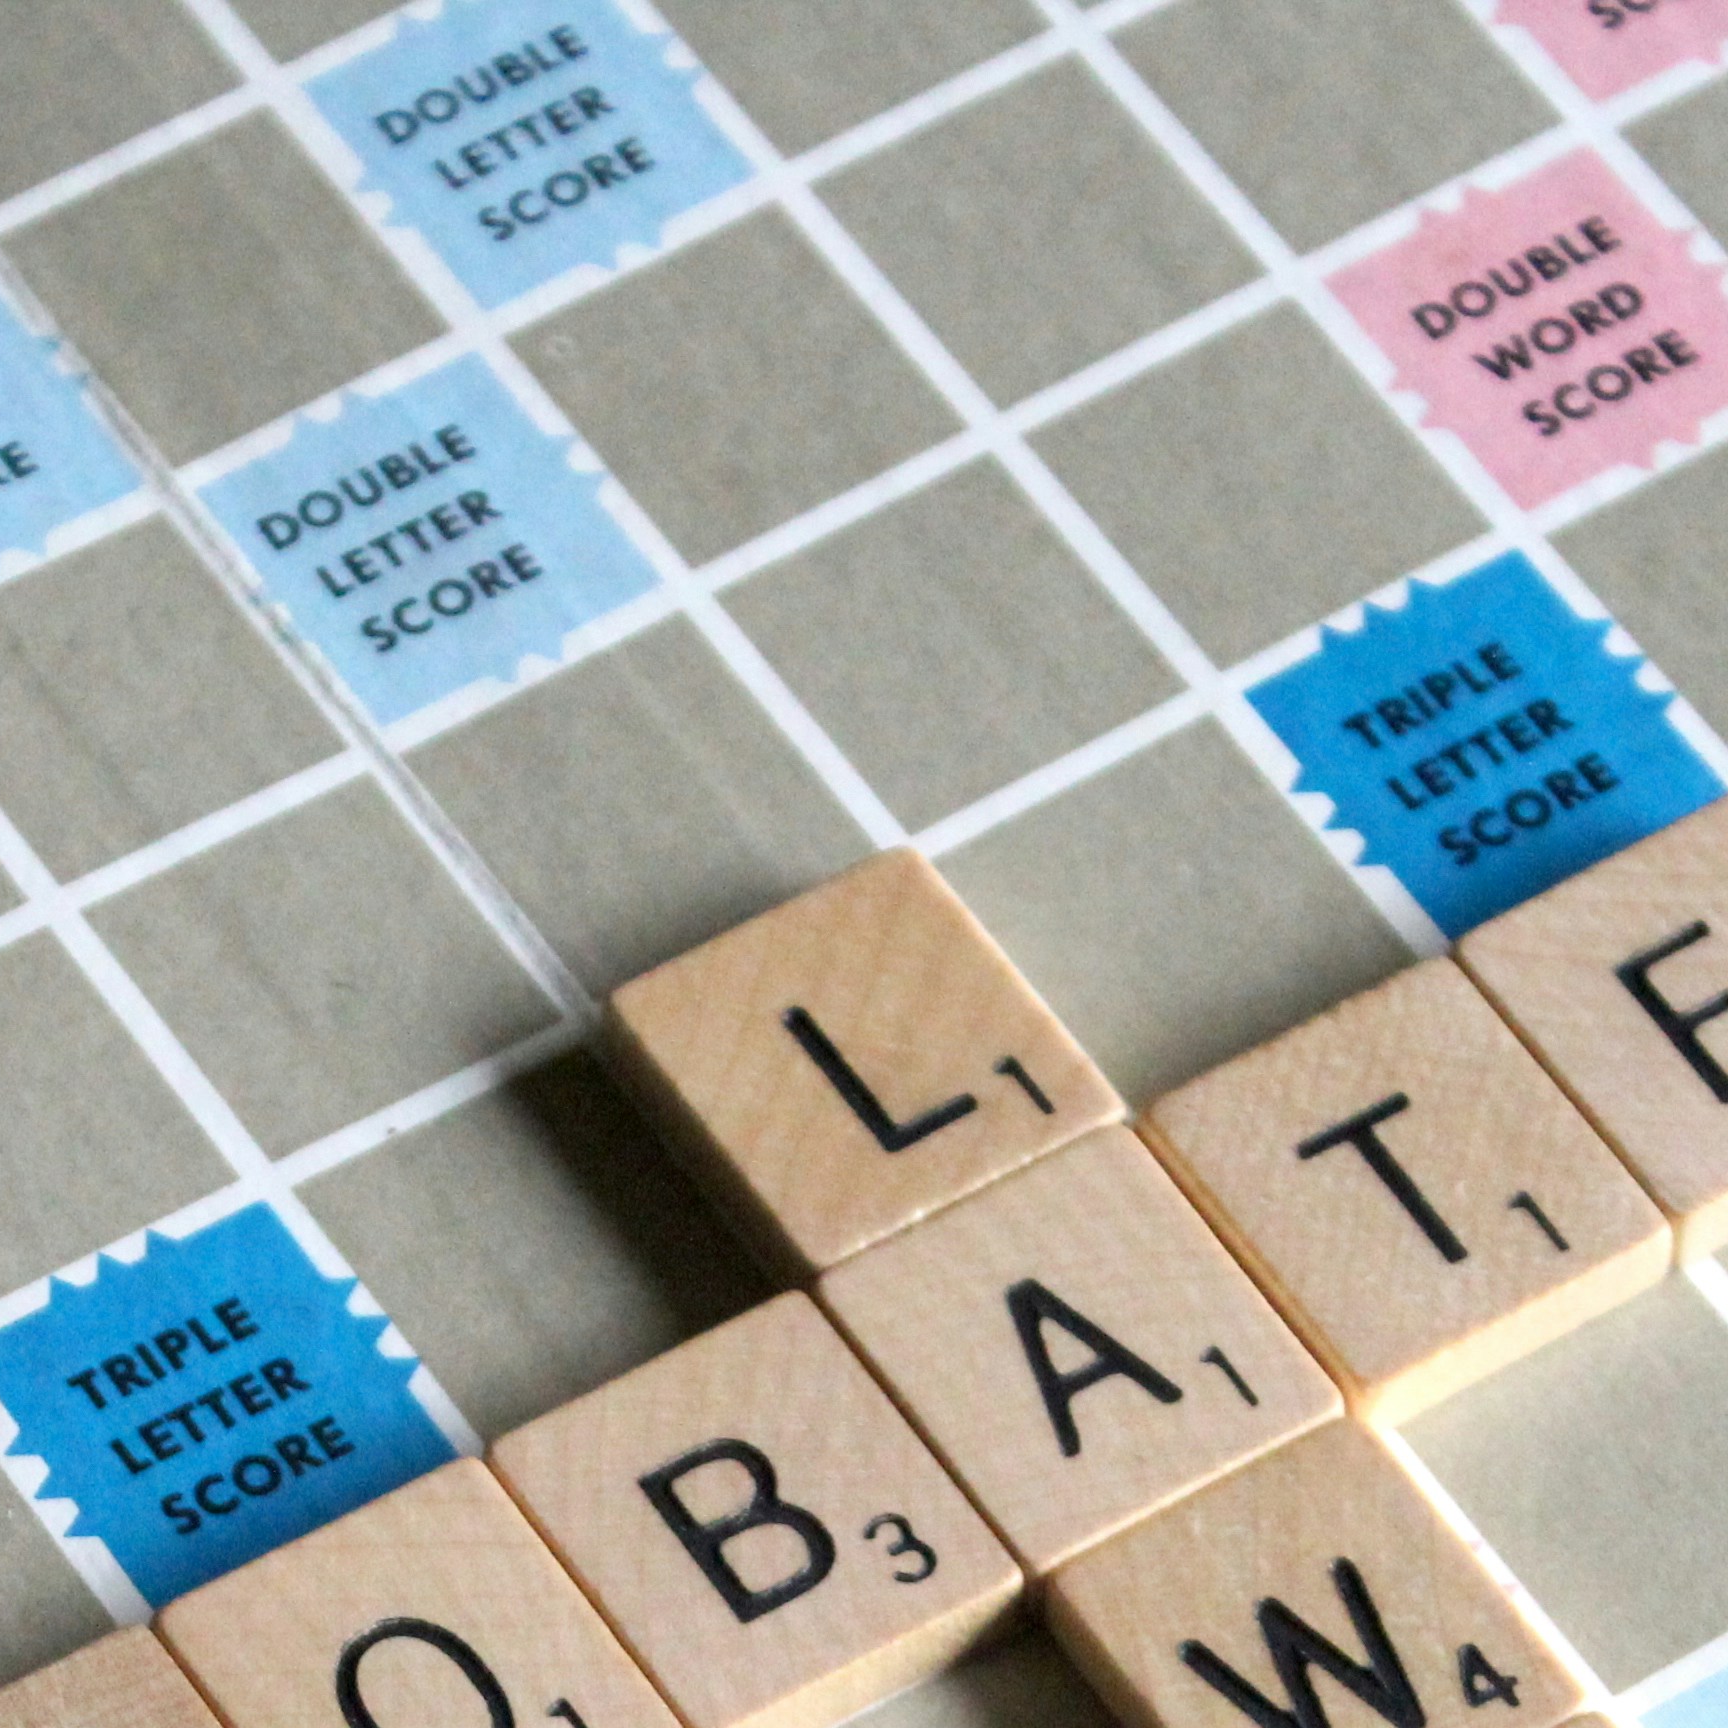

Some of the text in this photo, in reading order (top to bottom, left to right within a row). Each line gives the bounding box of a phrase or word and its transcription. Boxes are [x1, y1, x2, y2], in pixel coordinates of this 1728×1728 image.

[372, 24, 587, 148] DOUBLE
[432, 84, 614, 193] LETTER
[476, 135, 654, 244] SCORE
[1410, 219, 1620, 342] DOUBLE
[1474, 283, 1644, 382] WORD
[1522, 331, 1697, 438] SCORE
[256, 426, 475, 552] DOUBLE
[316, 490, 498, 600] LETTER
[360, 544, 541, 654] SCORE
[1342, 643, 1521, 750] TRIPLE
[1386, 698, 1574, 812] LETTER
[1438, 753, 1618, 867] SCORE
[782, 1005, 1057, 1154] L 1
[1295, 1091, 1570, 1265] T 1
[66, 1298, 259, 1411] TRIPLE
[1004, 1277, 1259, 1459] A 1
[109, 1357, 311, 1477] LETTER
[160, 1416, 356, 1537] SCORE
[636, 1437, 938, 1625] B 3
[1456, 1642, 1522, 1709] 4
